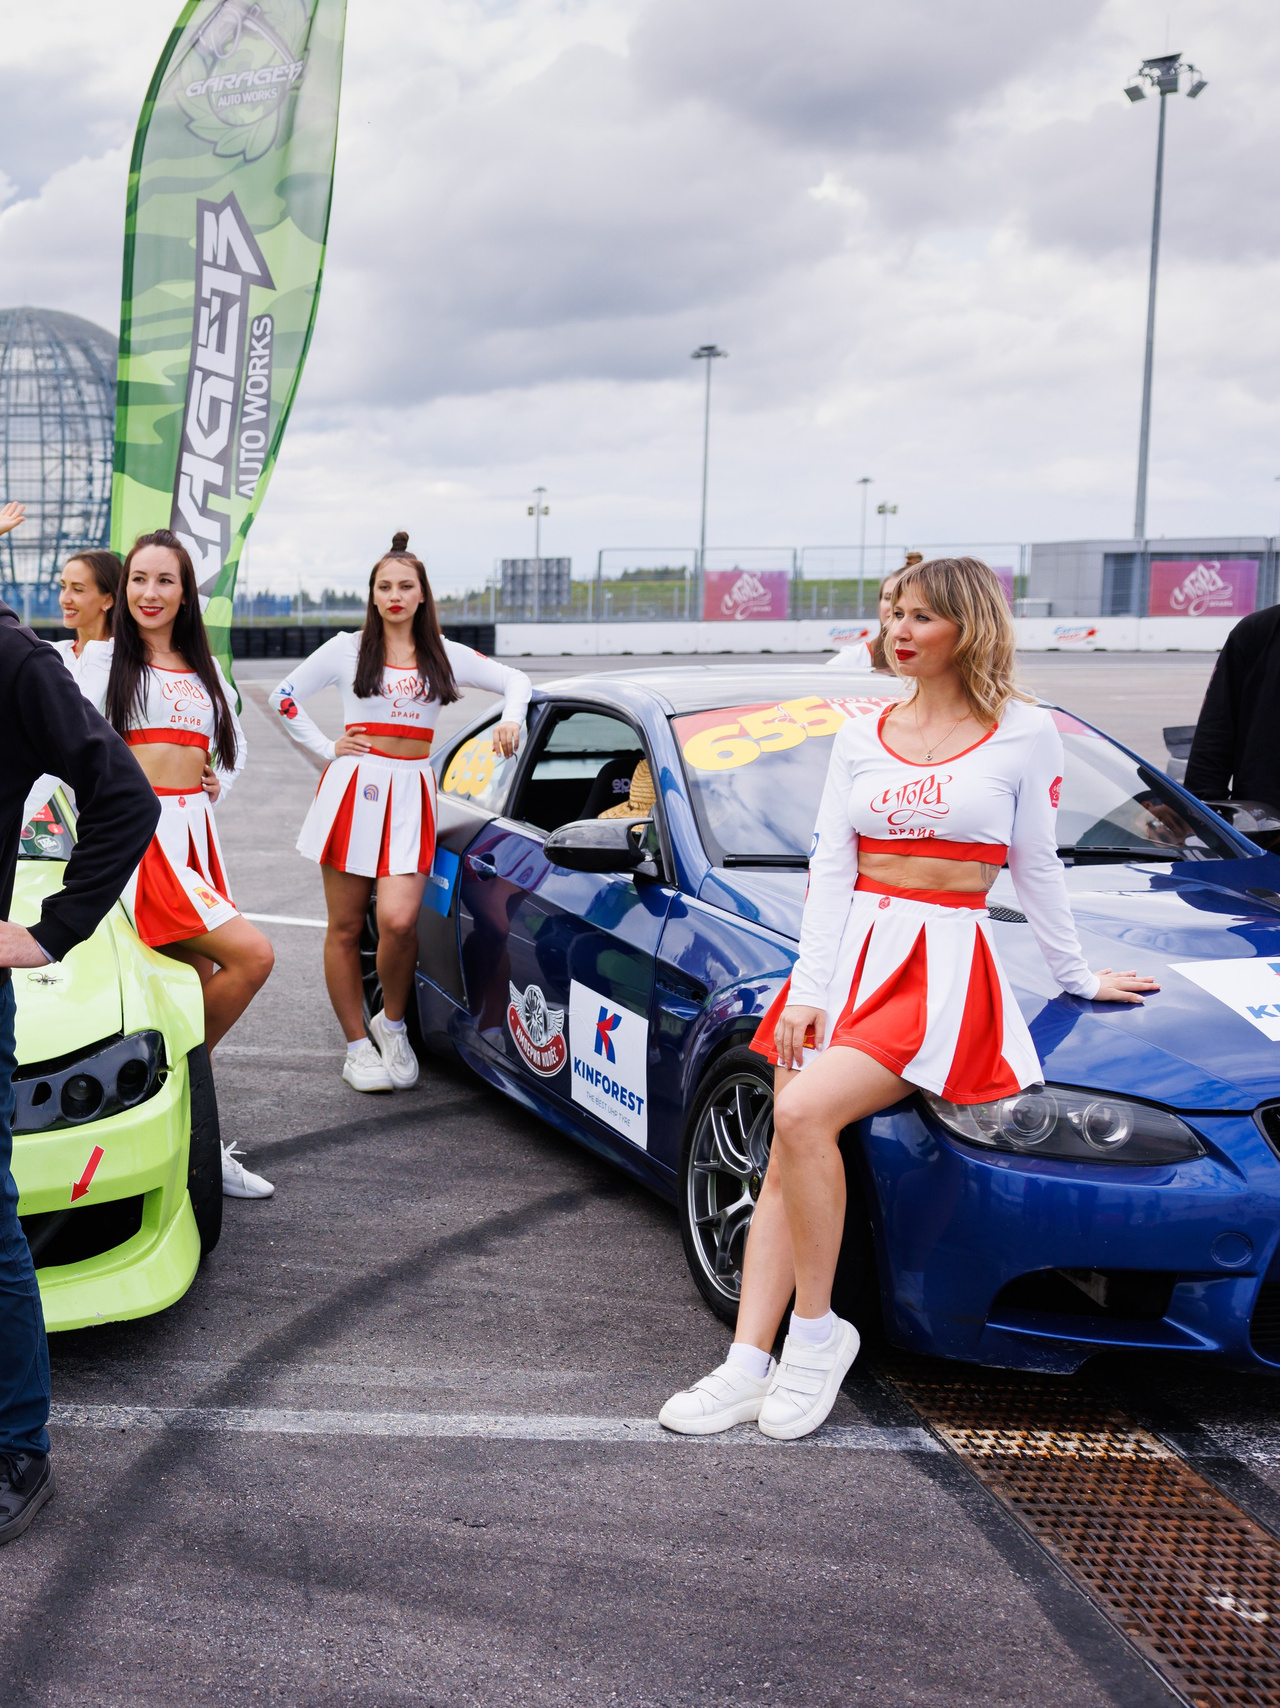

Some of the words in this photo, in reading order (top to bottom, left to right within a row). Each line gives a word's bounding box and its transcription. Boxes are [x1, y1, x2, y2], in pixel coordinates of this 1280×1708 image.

[218, 94, 240, 107] AUTO
[242, 87, 278, 103] WORKS
[241, 314, 273, 421] WORKS
[238, 430, 266, 500] AUTO
[170, 715, 201, 726] ДРАЙВ
[391, 711, 420, 719] ДРАЙВ
[683, 695, 848, 771] 655
[888, 827, 936, 838] ДРАЙВ
[574, 1056, 645, 1116] KINFOREST
[586, 1091, 595, 1103] THE
[595, 1097, 607, 1110] BEST
[619, 1112, 631, 1127] TYRE
